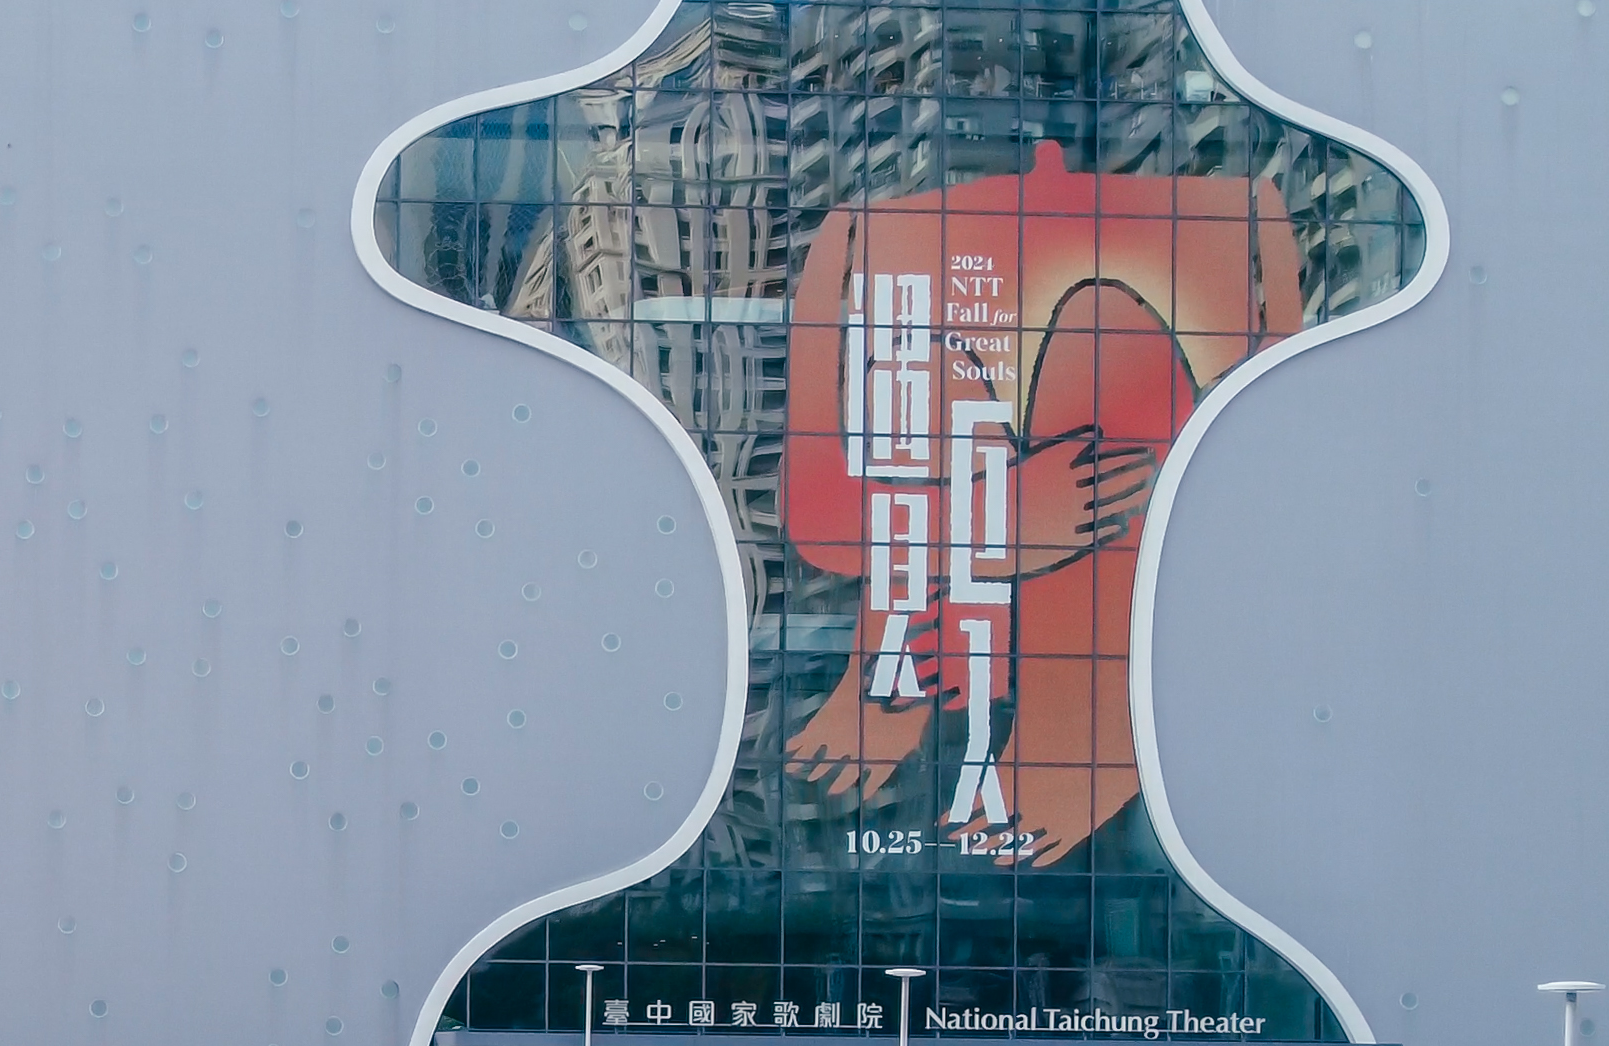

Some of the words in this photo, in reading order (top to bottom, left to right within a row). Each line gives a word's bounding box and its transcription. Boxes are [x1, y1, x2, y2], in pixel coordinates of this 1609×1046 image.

[950, 255, 995, 272] 2024
[951, 276, 1004, 297] NTT
[946, 303, 989, 323] Fall
[990, 307, 1017, 326] for
[944, 332, 1012, 352] Great
[951, 360, 1017, 381] Souls
[603, 999, 883, 1029] 臺中國家歌劇院
[924, 1006, 1037, 1031] National
[1042, 1008, 1160, 1039] Taichung
[1166, 1009, 1266, 1034] Theater
